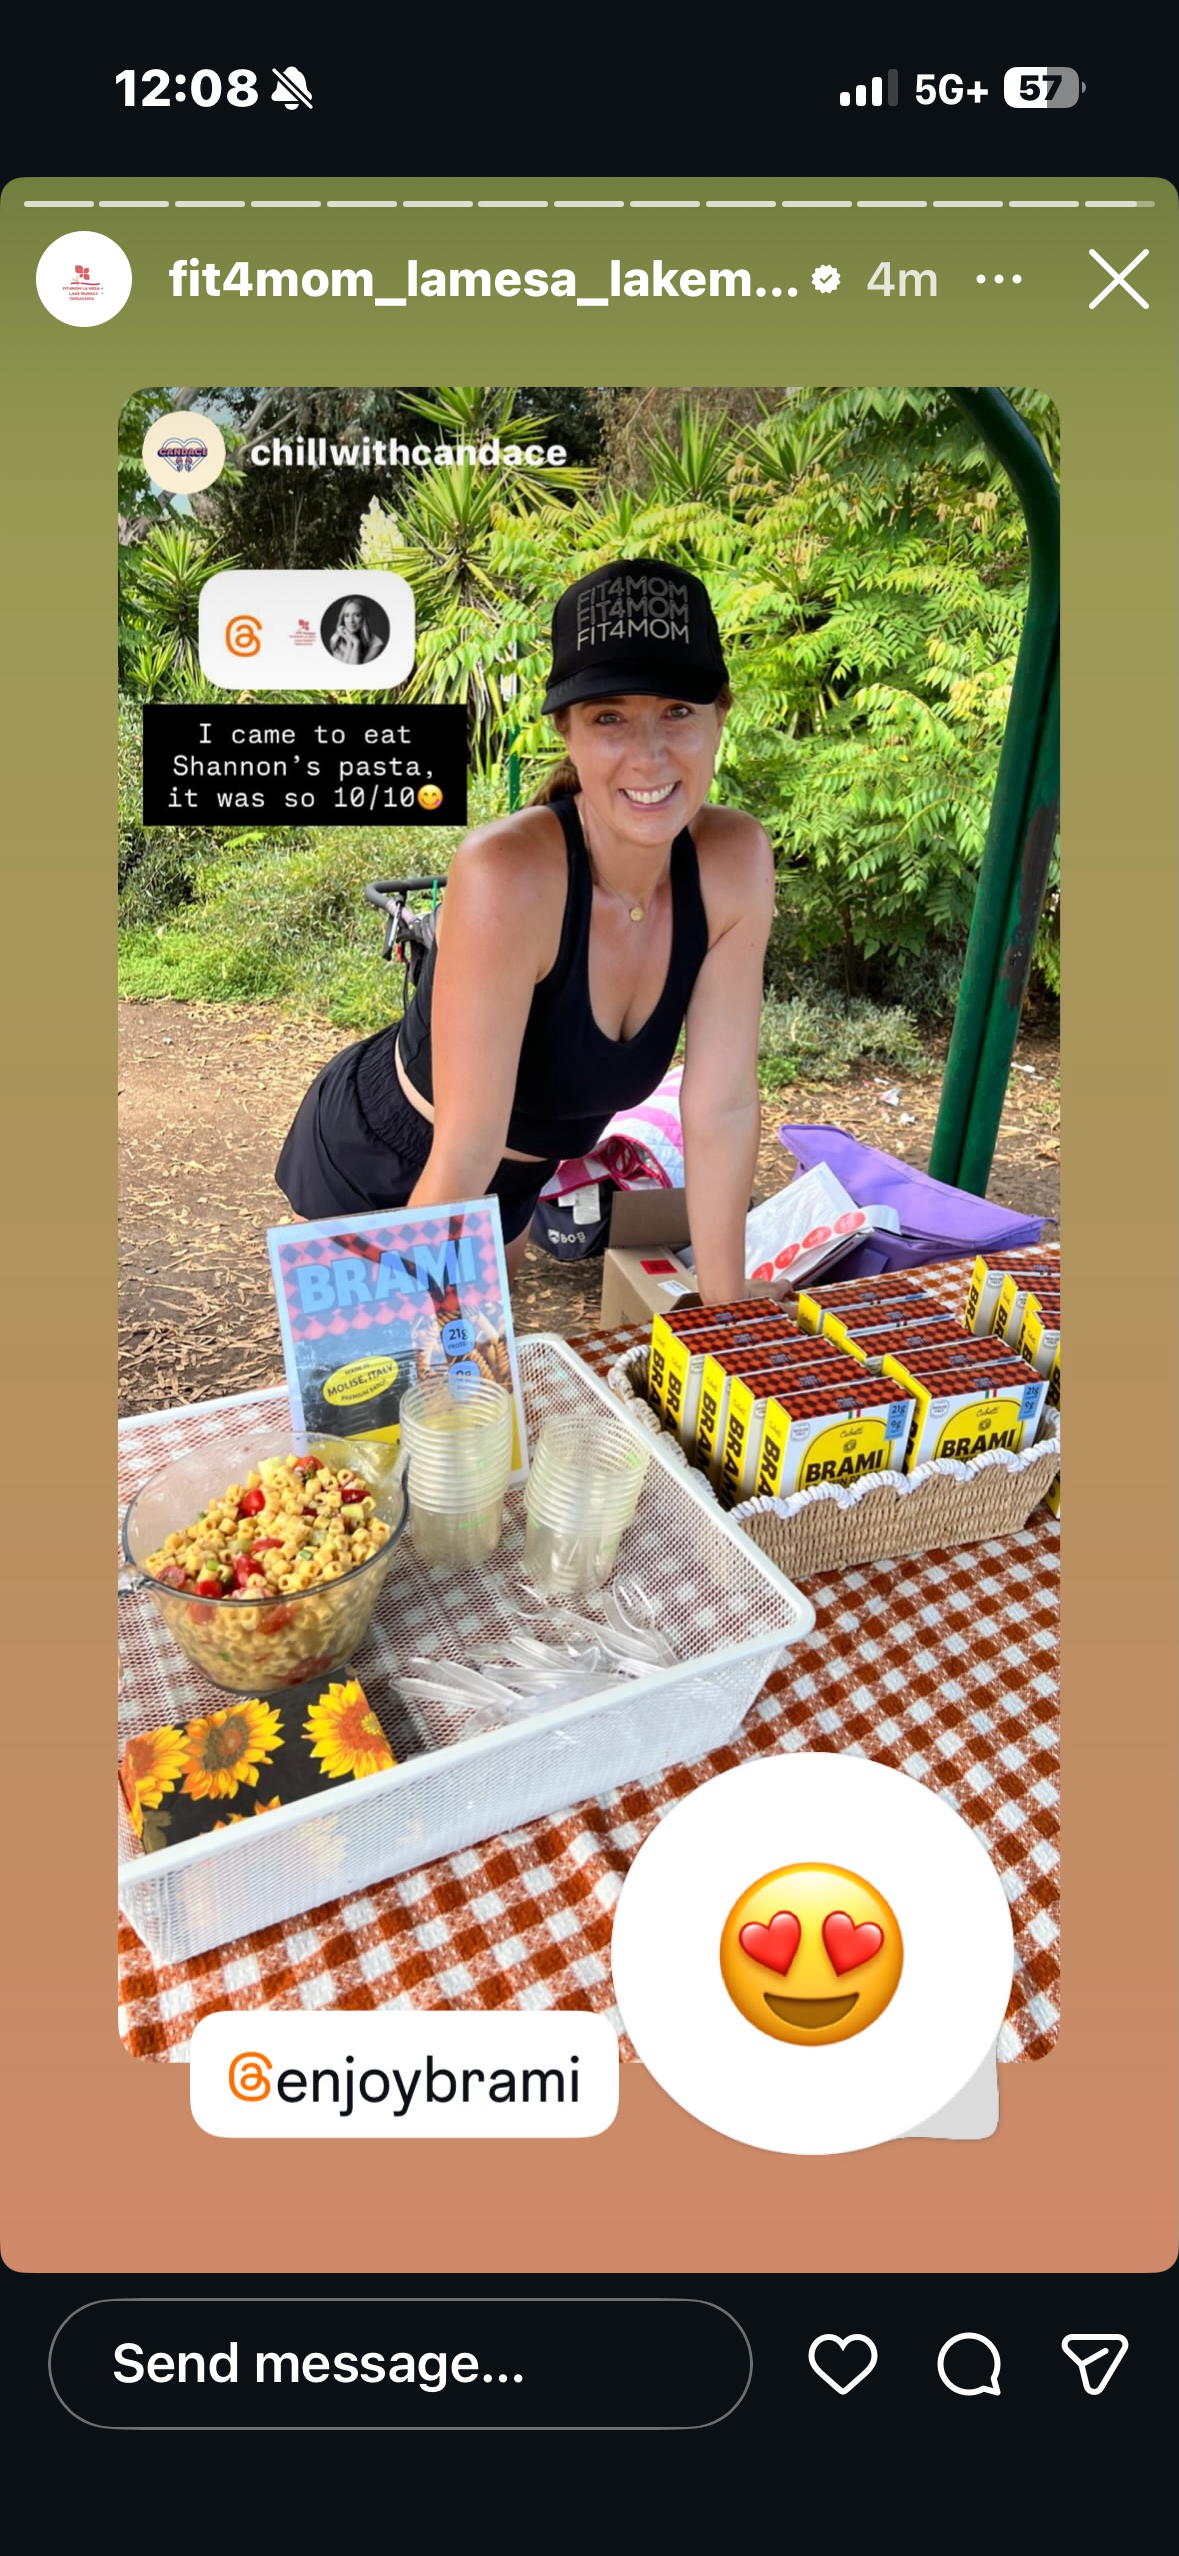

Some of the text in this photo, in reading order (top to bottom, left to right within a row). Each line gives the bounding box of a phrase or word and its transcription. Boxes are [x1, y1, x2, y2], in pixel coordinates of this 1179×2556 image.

[577, 575, 688, 611] FIT4MOM
[577, 595, 689, 631] FIT4MOM
[576, 617, 689, 651] FIT4MOM
[296, 1238, 476, 1314] BRAMI
[327, 1363, 393, 1397] MOLISE, ITALY
[941, 1429, 1015, 1459] BRAMI
[805, 1449, 883, 1483] BRAMI
